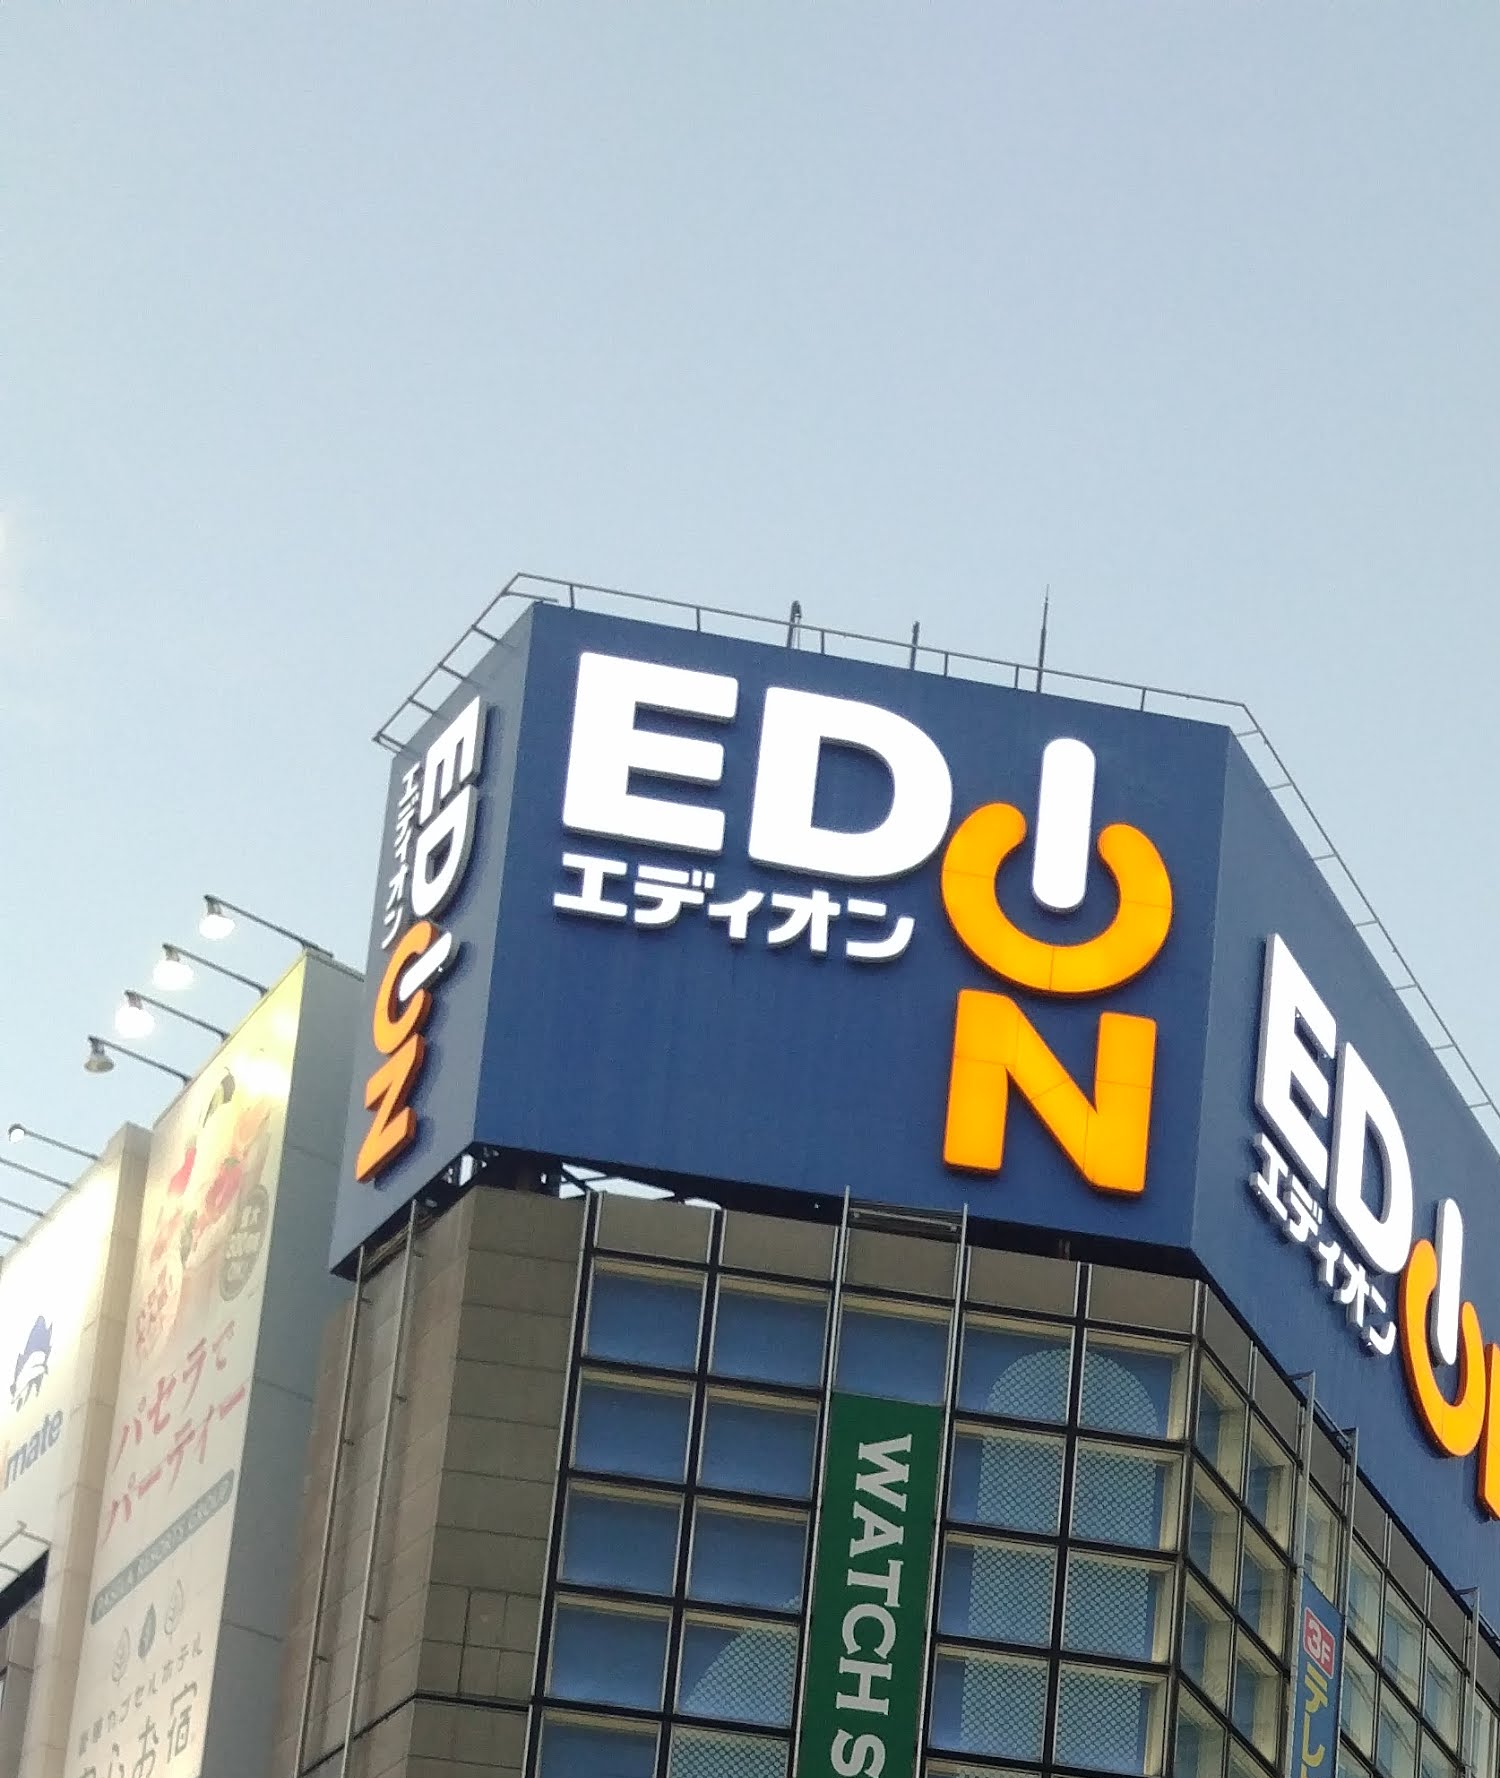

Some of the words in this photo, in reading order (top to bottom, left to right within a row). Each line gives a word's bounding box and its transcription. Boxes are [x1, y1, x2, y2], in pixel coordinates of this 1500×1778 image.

[382, 761, 421, 950] エディオン
[553, 852, 916, 963] エディオン
[1250, 1133, 1397, 1356] エディオン
[834, 1433, 912, 1715] WATCH
[1304, 1612, 1333, 1678] 3F
